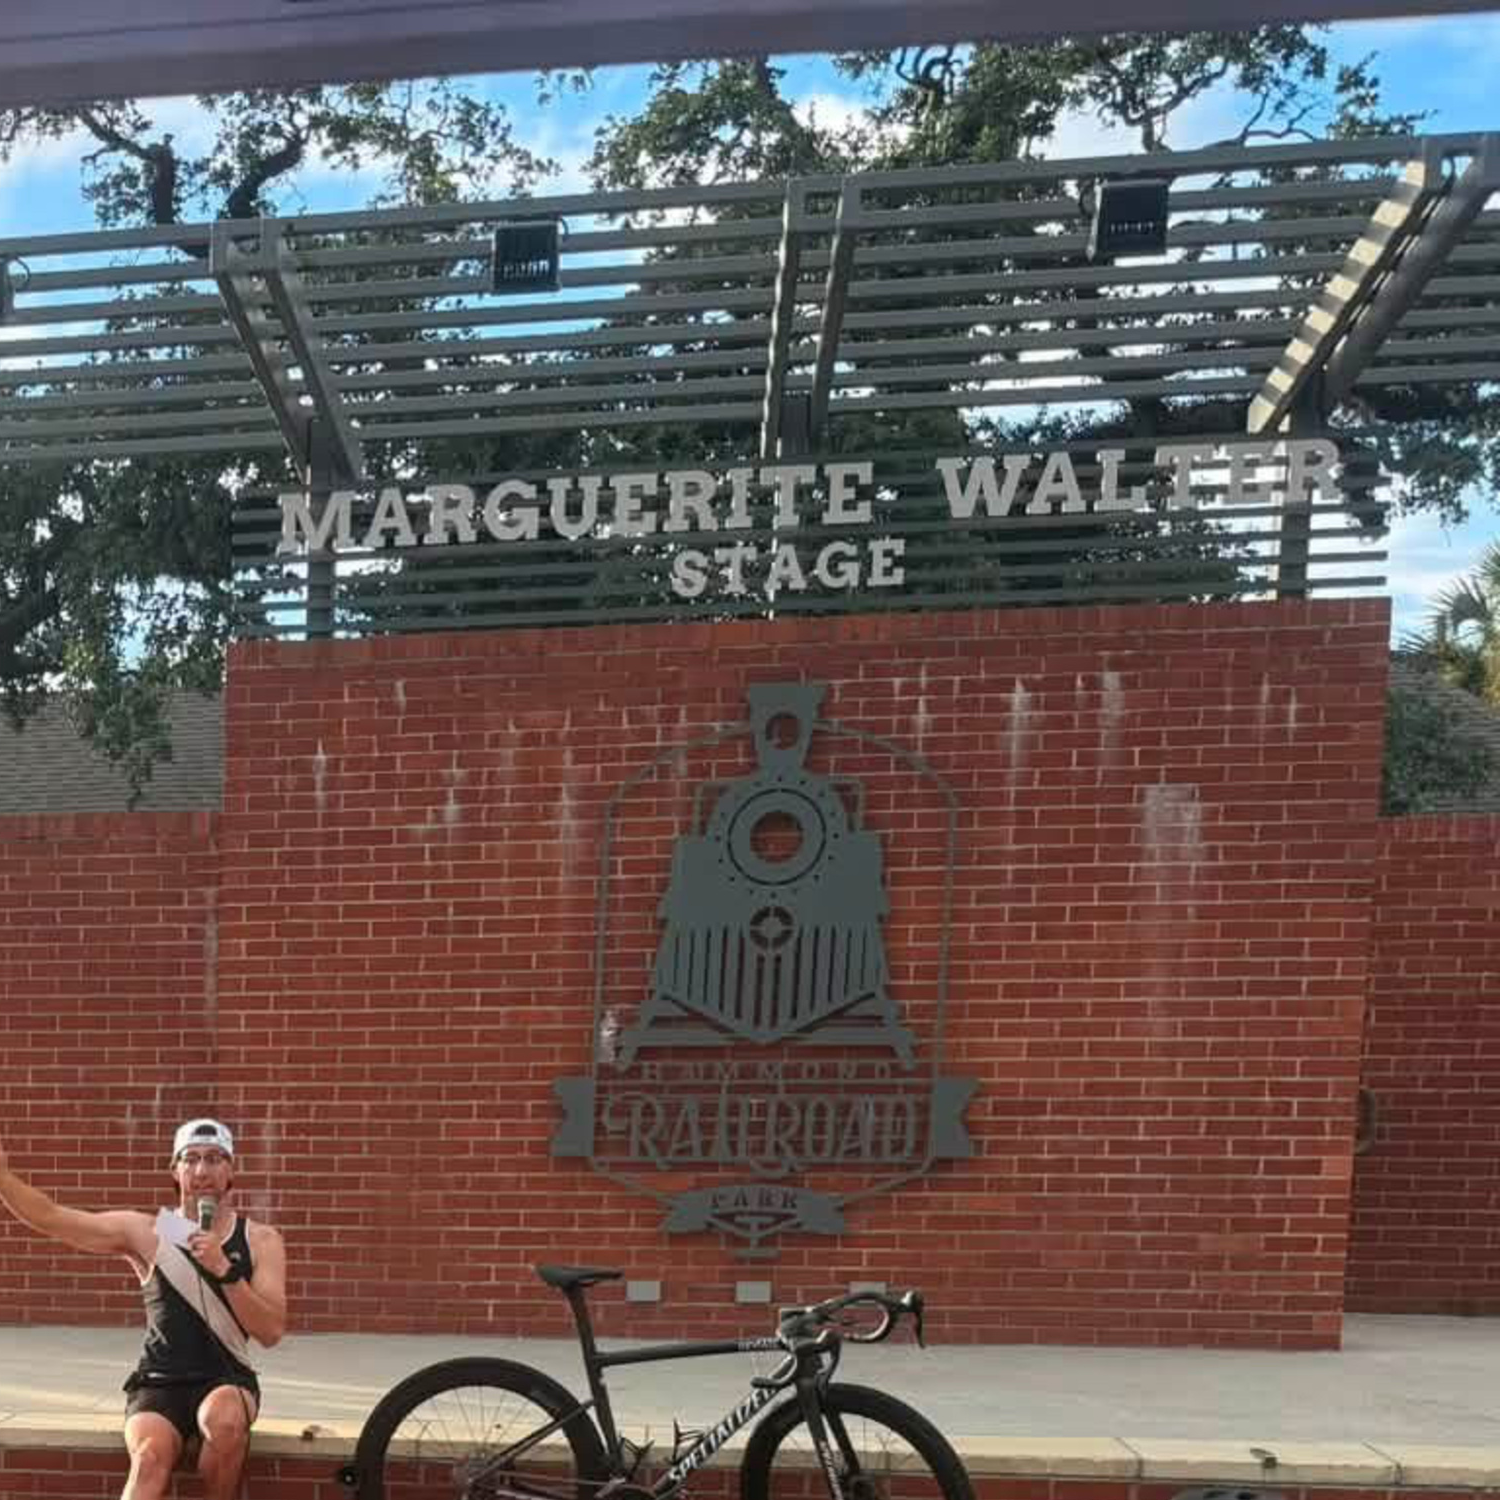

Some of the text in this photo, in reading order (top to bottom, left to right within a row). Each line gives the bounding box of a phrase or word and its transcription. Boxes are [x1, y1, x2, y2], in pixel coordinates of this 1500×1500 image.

[277, 437, 1344, 555] MARGUERITE WALTER
[670, 536, 906, 599] STAGE
[603, 1092, 916, 1177] RAILROAD
